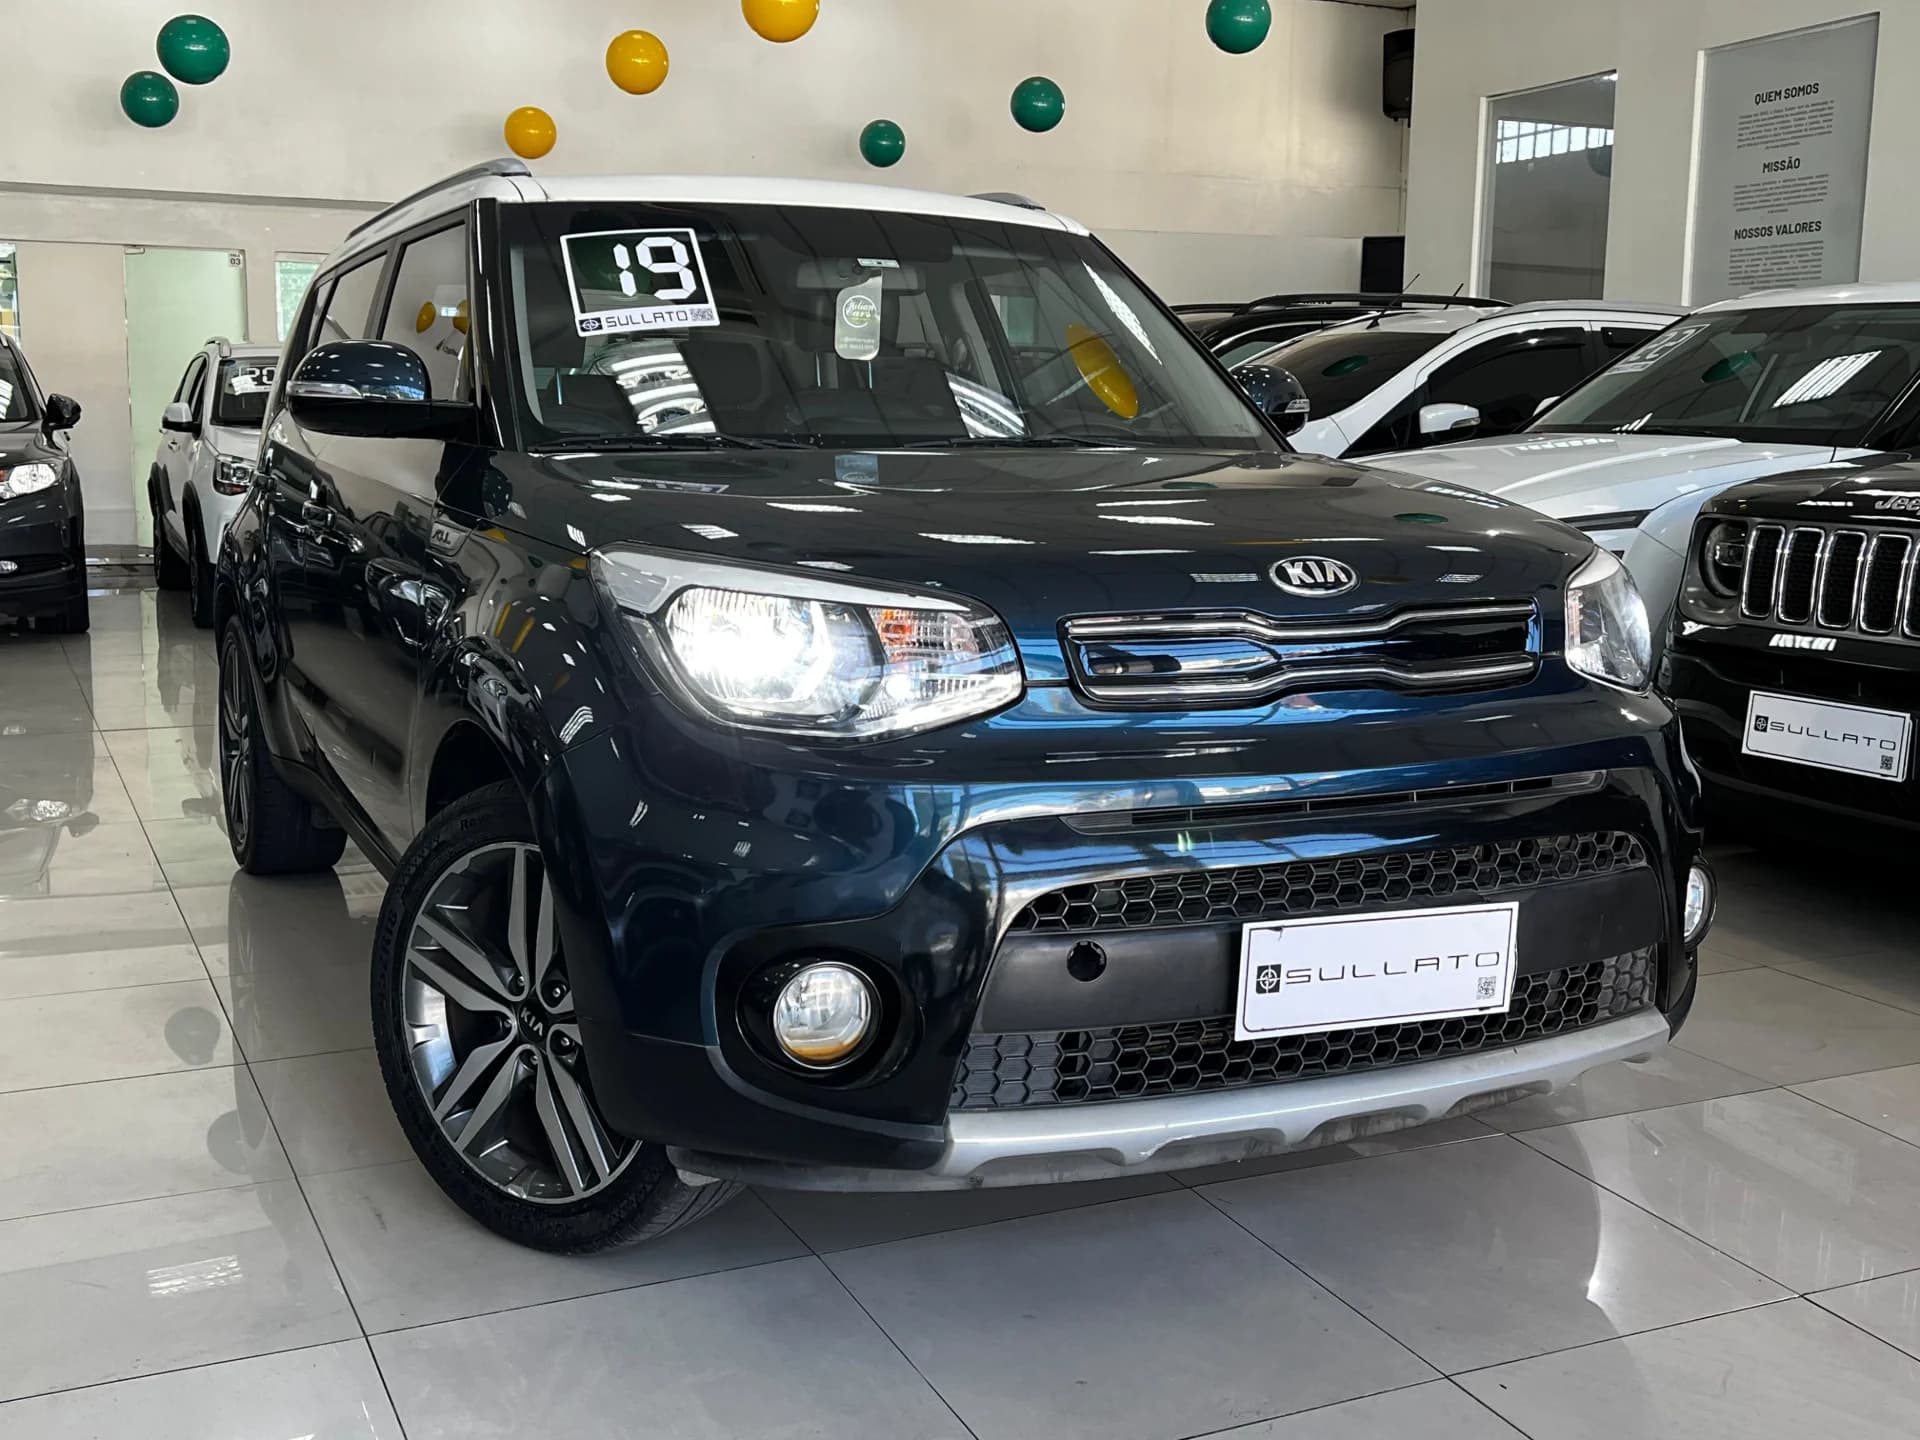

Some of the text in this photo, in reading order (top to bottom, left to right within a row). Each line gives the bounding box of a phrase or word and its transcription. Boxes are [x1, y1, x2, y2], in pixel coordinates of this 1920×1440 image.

[1754, 82, 1820, 106] QUEM SOMOS
[1762, 156, 1801, 174] MISSÃO
[1734, 220, 1822, 240] NOSSOS VALORES
[613, 236, 697, 300] 19
[605, 310, 689, 328] SULLATO
[1874, 496, 1920, 515] Jee
[1281, 561, 1349, 585] KIA
[1769, 720, 1897, 751] SULLATO
[1285, 952, 1500, 985] SULLATO
[520, 1007, 543, 1037] KIA
